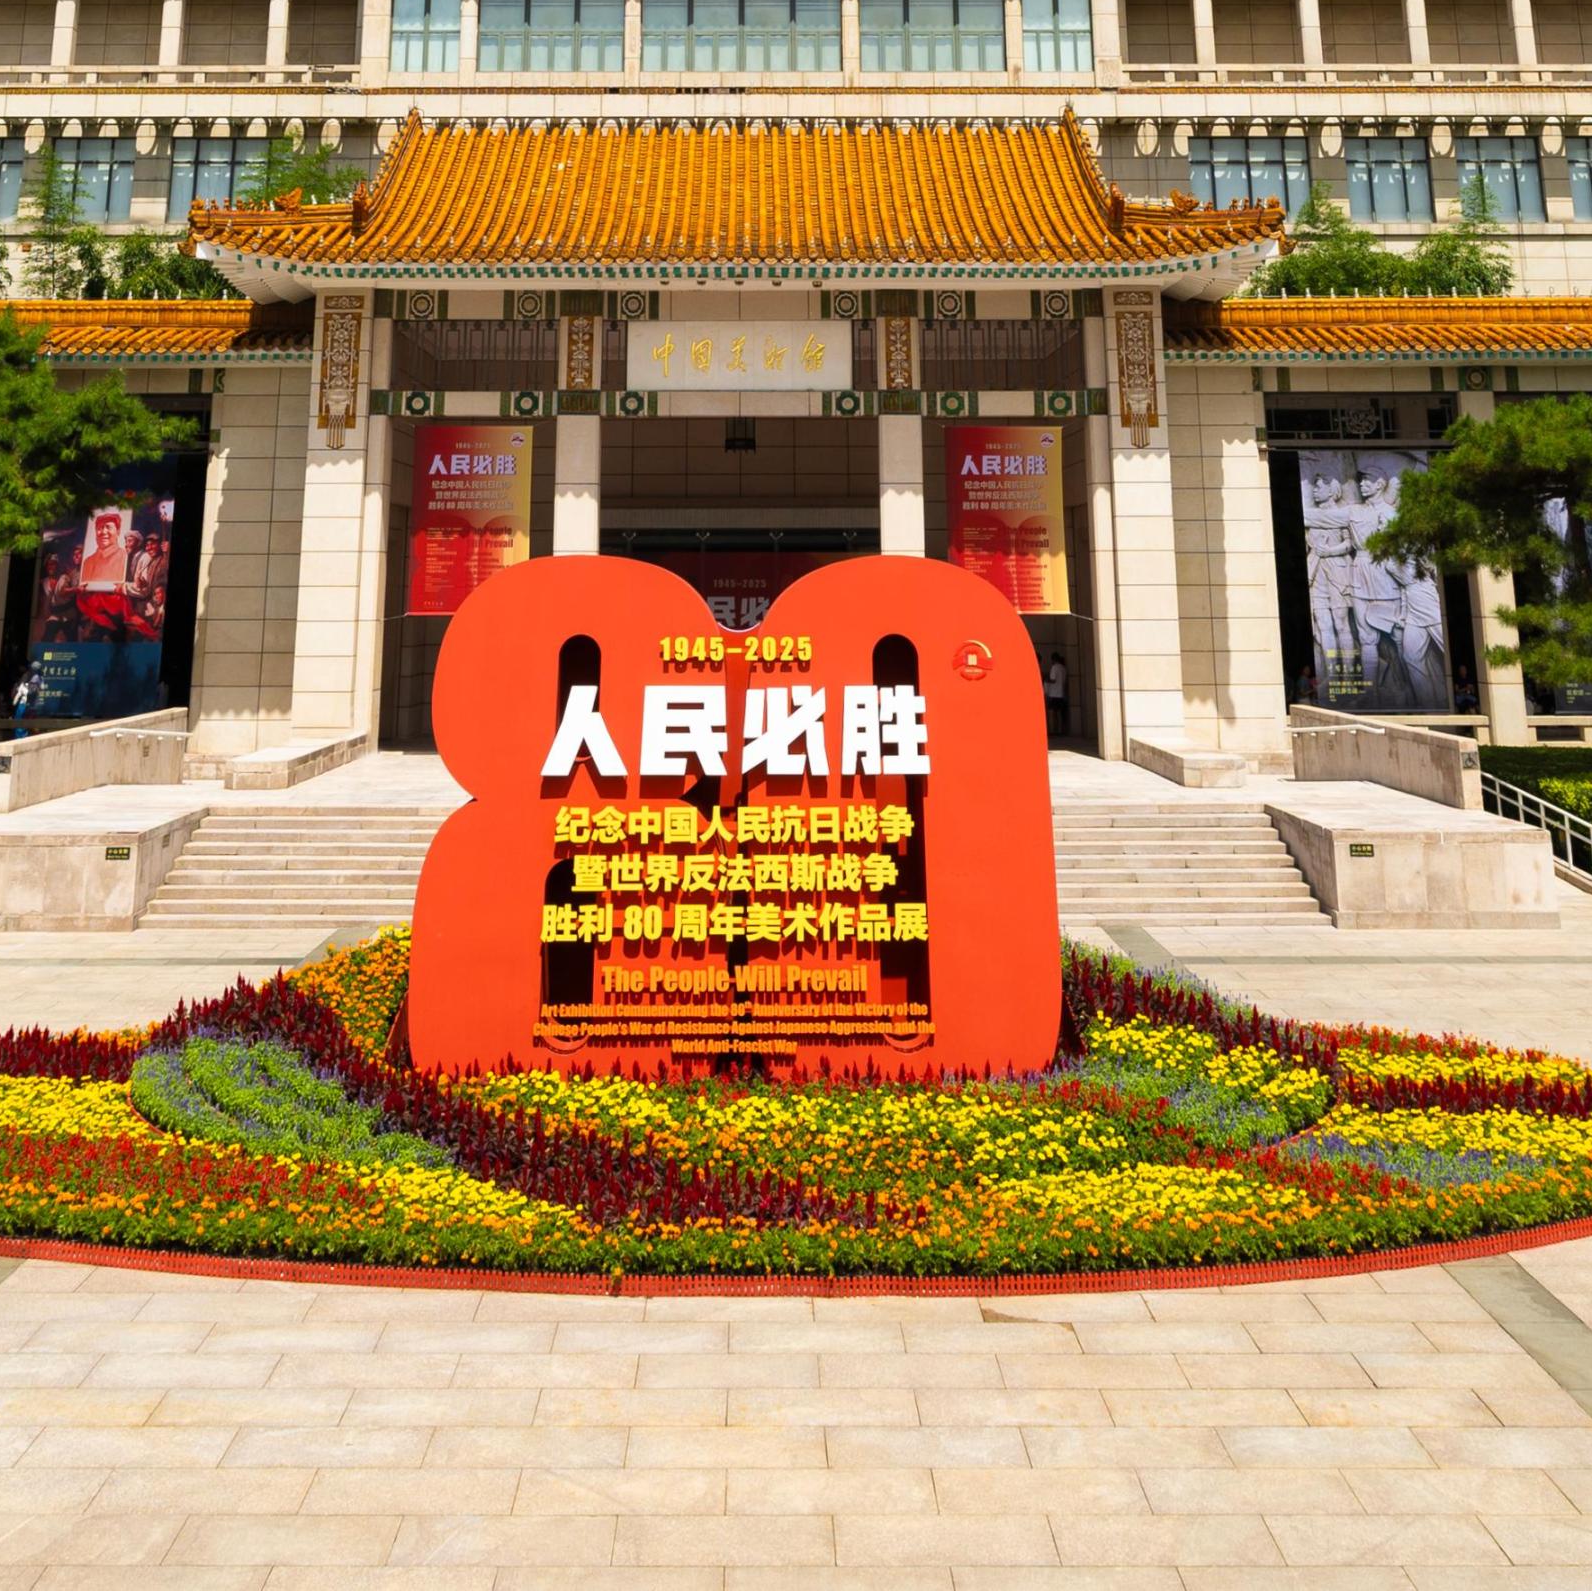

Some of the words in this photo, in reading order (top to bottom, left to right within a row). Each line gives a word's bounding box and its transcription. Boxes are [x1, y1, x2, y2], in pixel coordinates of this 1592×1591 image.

[429, 454, 517, 475] 人民必胜
[960, 455, 1048, 475] 人民必胜
[659, 636, 813, 661] 1945-2025
[540, 684, 931, 777] 人民必胜
[554, 805, 915, 845] 纪念中国人民抗日战争
[571, 853, 899, 892] 暨世界反法西斯战争
[540, 904, 613, 943] 胜利
[623, 904, 663, 943] 80
[672, 903, 930, 943] 周年美术作品展
[601, 965, 644, 992] The
[650, 965, 730, 995] People
[734, 965, 781, 992] Will
[787, 965, 868, 992] Prevail
[541, 1004, 558, 1017] Art
[559, 1003, 614, 1017] Exhibition
[616, 1003, 708, 1018] Commemorating
[710, 1003, 729, 1017] the
[752, 1002, 820, 1017] Anniversary
[822, 1002, 833, 1016] of
[835, 1003, 853, 1016] the
[855, 1002, 895, 1017] Victory
[896, 1002, 908, 1016] of
[909, 1002, 928, 1016] the
[533, 1022, 579, 1036] Chinese
[580, 1022, 628, 1037] People's
[629, 1021, 653, 1035] War
[654, 1021, 666, 1035] of
[667, 1021, 730, 1035] Resistance
[731, 1021, 774, 1036] Against
[775, 1020, 828, 1035] Japanese
[829, 1020, 892, 1035] Aggression
[894, 1020, 916, 1034] and
[917, 1020, 936, 1034] the
[672, 1039, 706, 1053] World
[707, 1039, 774, 1054] Anti-Fascist
[774, 1039, 798, 1054] War
